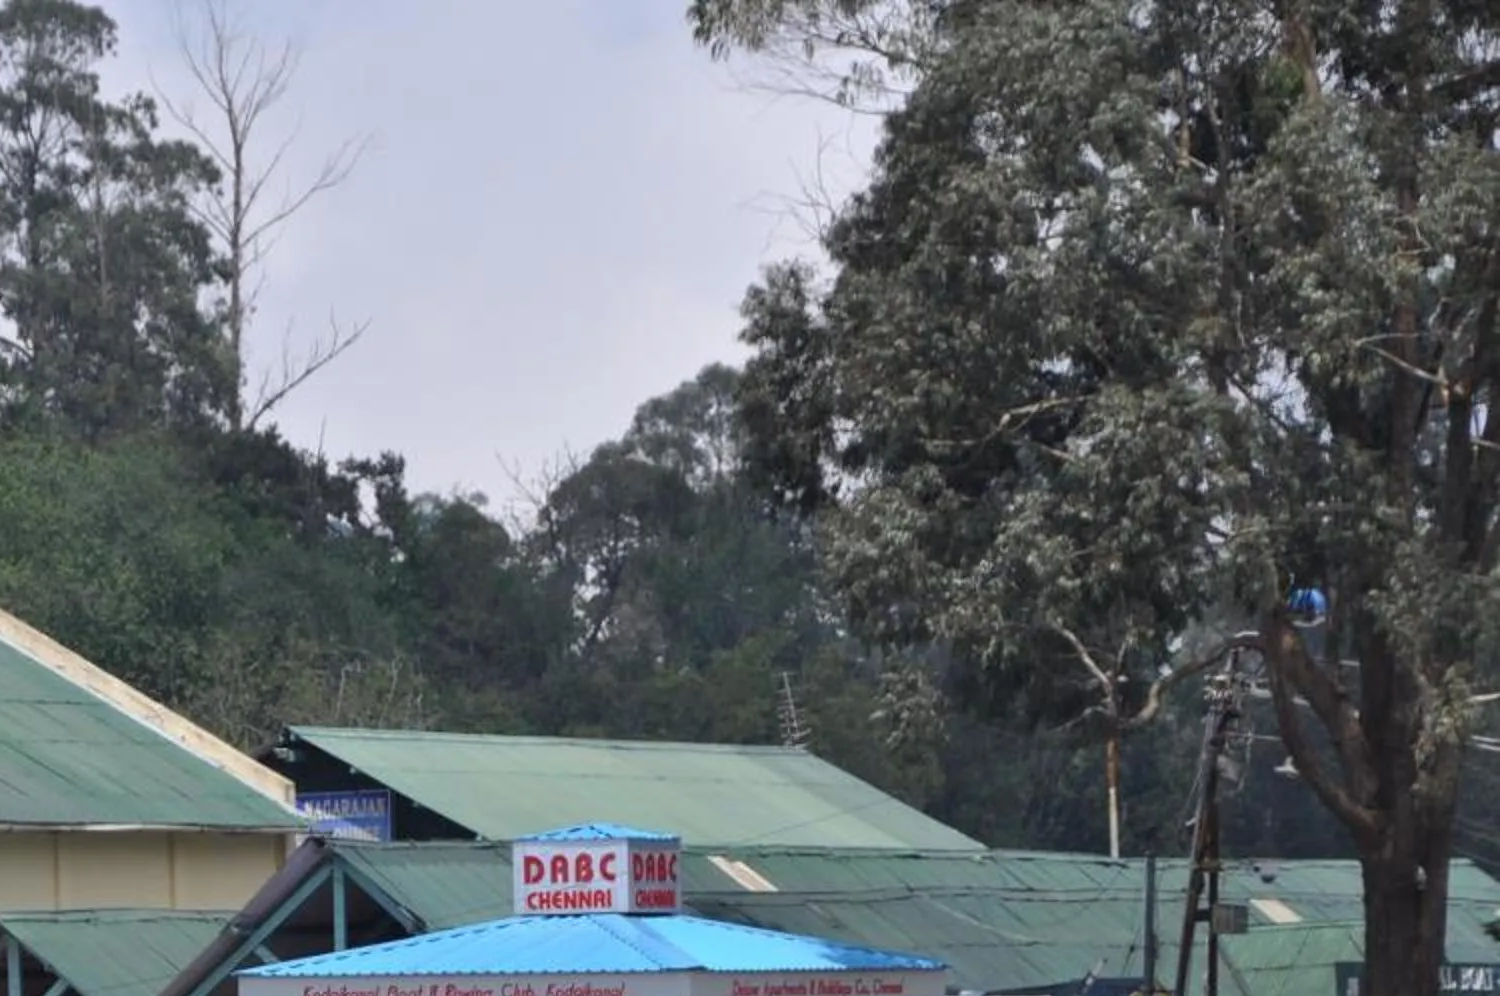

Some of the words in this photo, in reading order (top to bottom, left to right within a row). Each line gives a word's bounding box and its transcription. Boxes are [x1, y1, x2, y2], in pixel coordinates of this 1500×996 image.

[523, 852, 617, 884] DABC
[632, 852, 677, 882] DABC
[527, 888, 613, 910] CHENNAI
